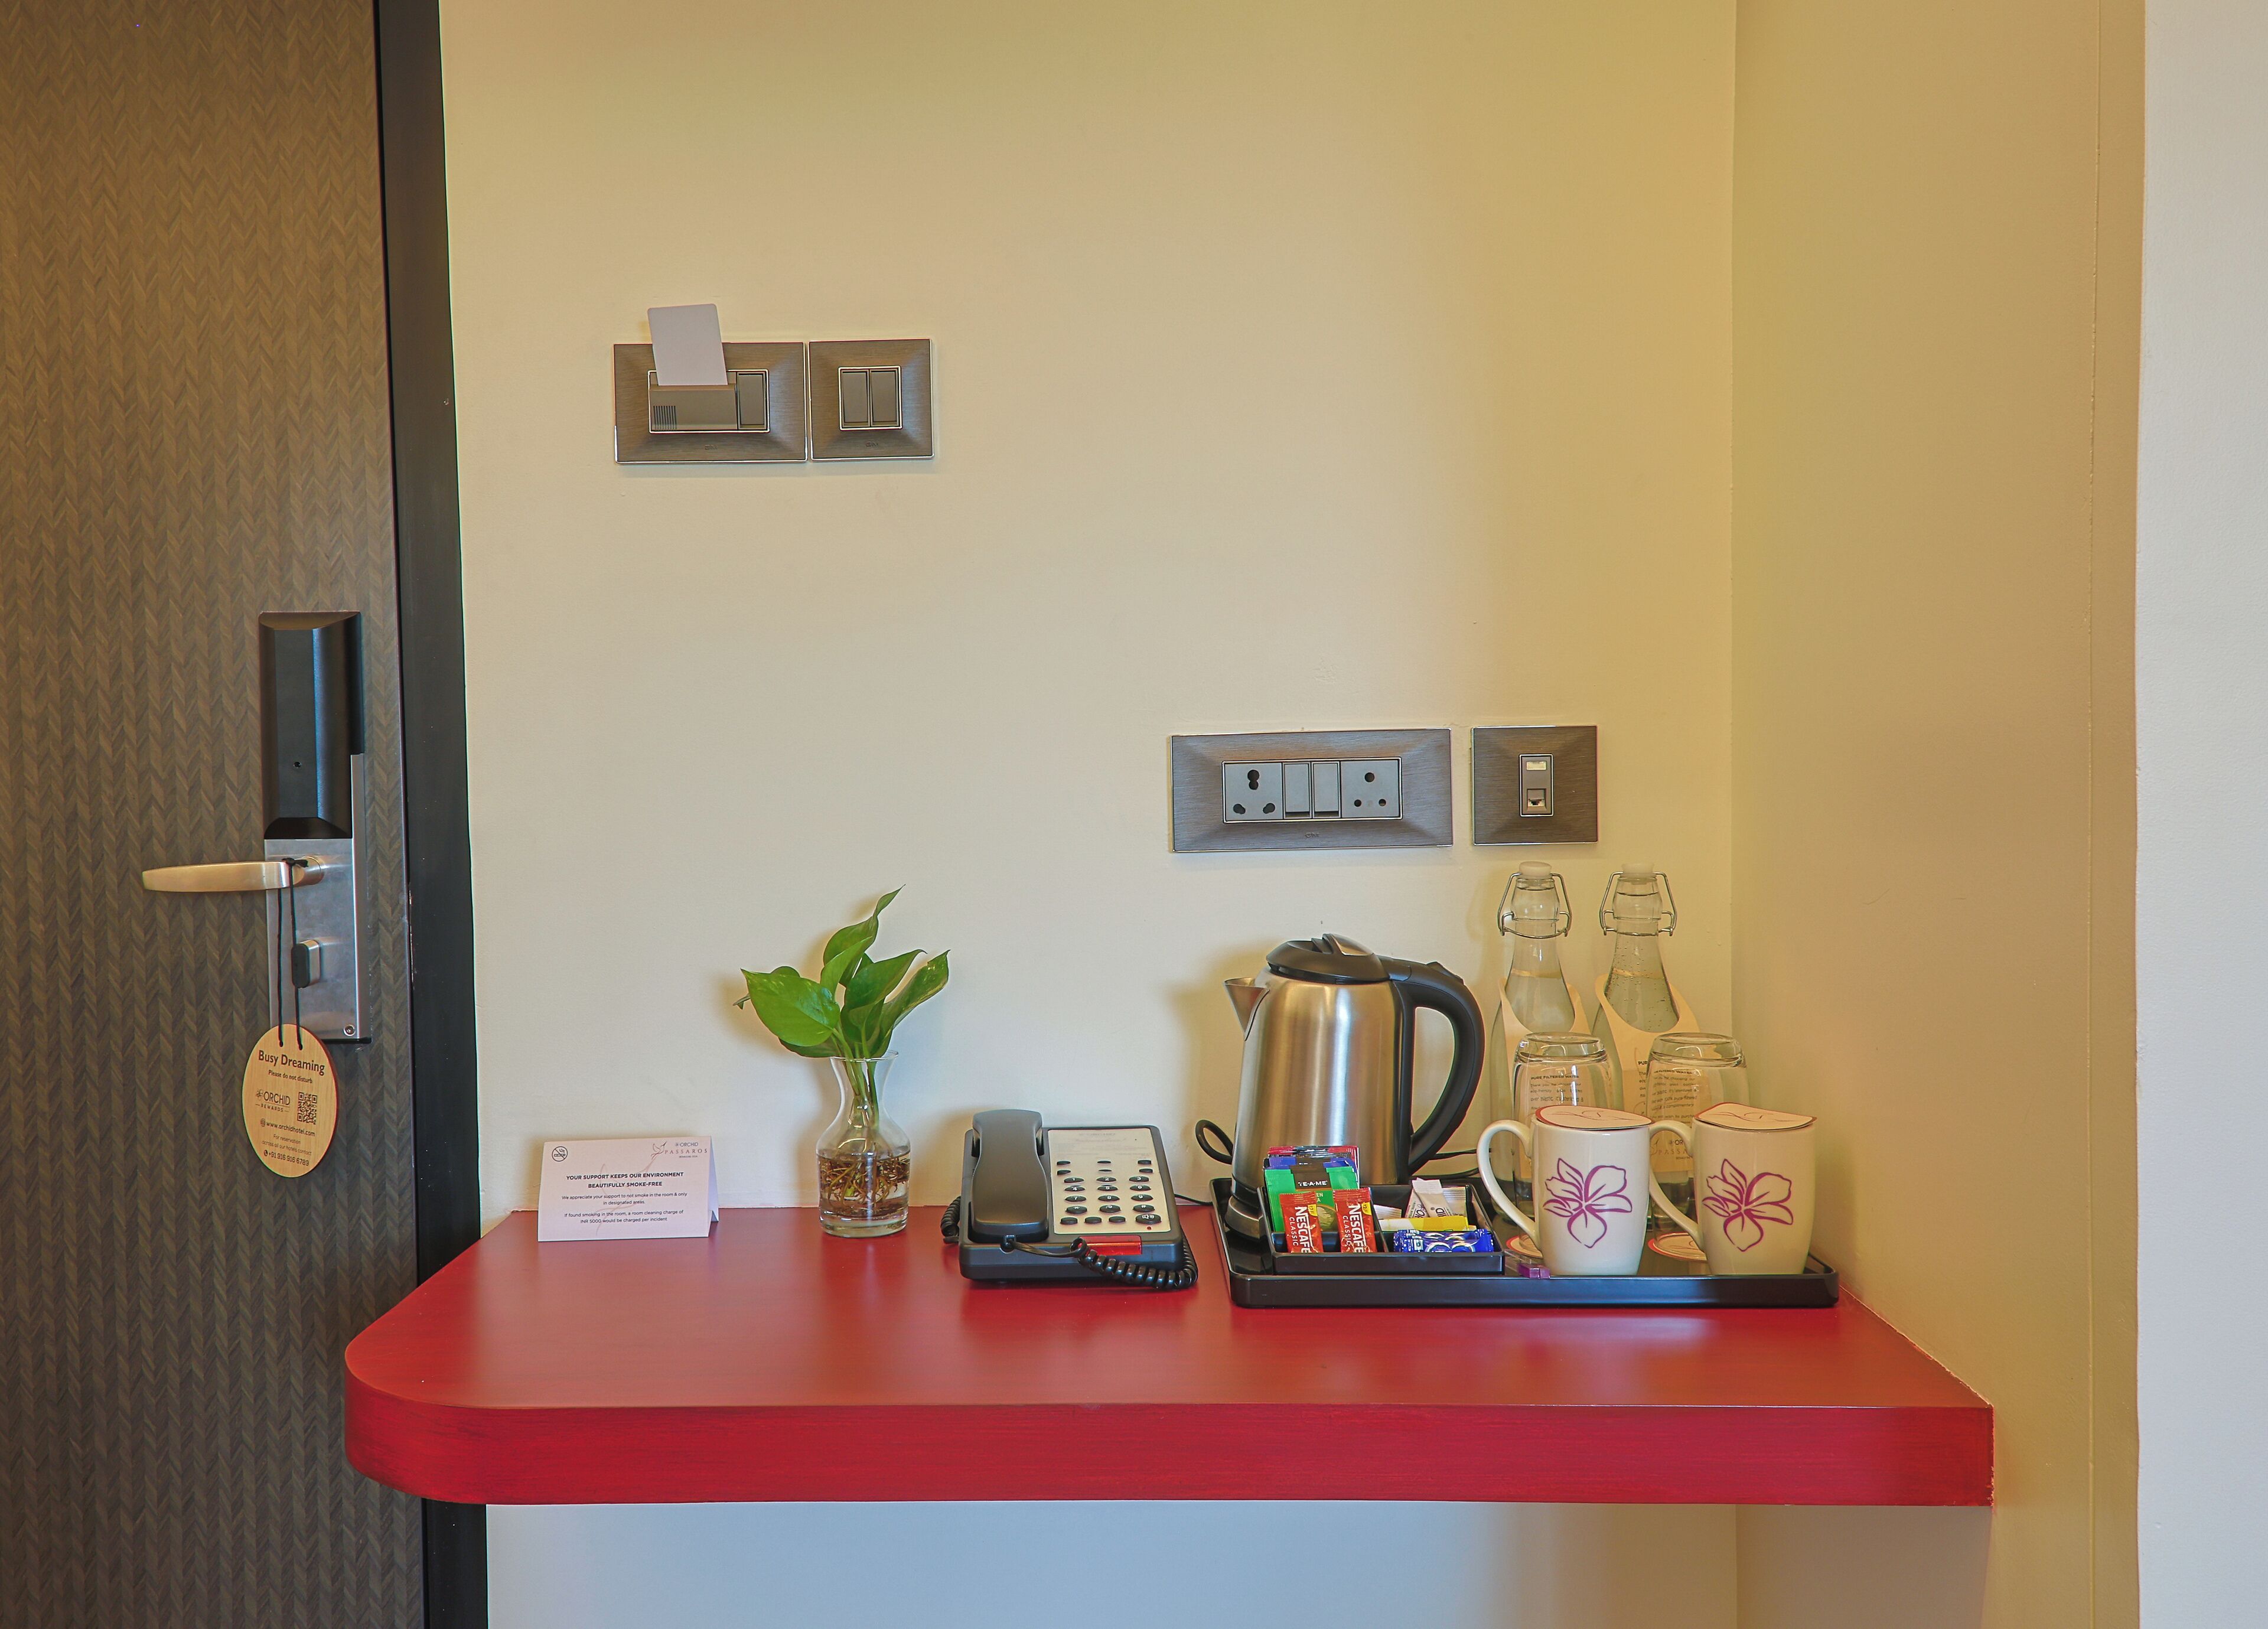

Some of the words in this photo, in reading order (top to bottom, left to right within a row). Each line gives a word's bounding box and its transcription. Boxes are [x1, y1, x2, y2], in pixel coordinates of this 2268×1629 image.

[259, 1050, 279, 1067] Busy
[281, 1054, 325, 1076] Dreaming
[263, 1091, 291, 1106] ORCHID
[261, 1103, 284, 1112] REWARDS
[266, 1122, 315, 1136] www.orchidhotel.com
[296, 1158, 309, 1167] 6789
[1289, 1217, 1299, 1246] CLASSIC
[1342, 1215, 1351, 1246] CLASSIC
